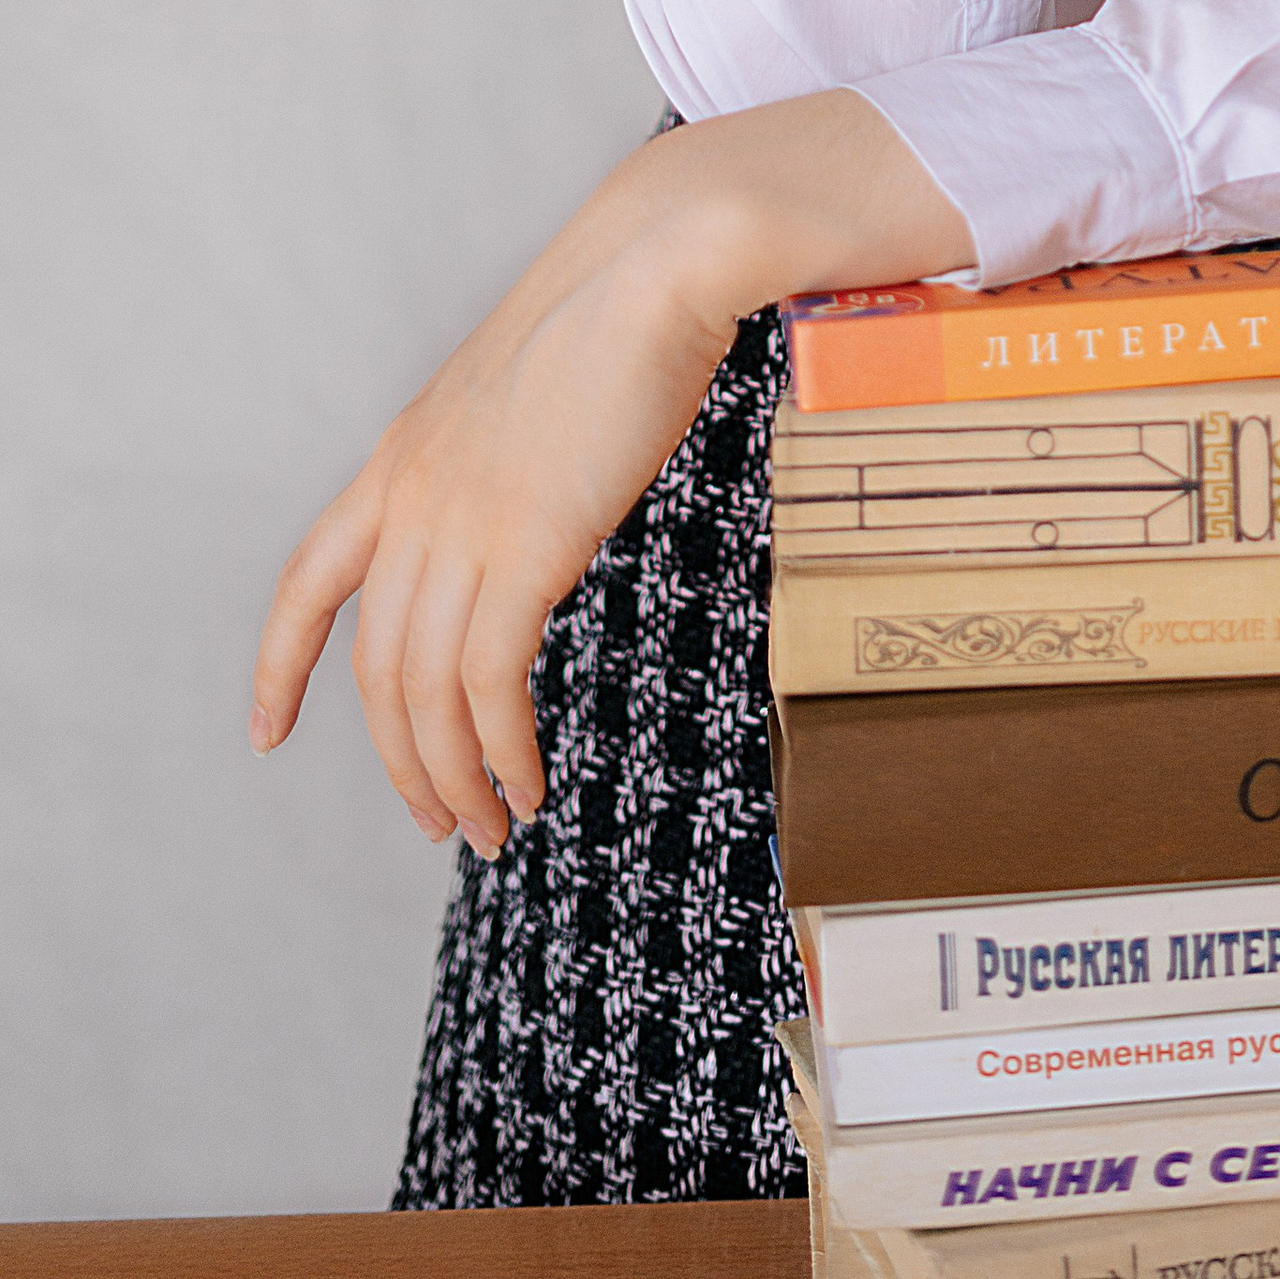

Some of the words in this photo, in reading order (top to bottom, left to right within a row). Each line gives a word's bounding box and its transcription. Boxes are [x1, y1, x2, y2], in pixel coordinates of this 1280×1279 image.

[1139, 617, 1267, 645] РУССКИЕ
[976, 1036, 1215, 1079] Современная
[940, 1154, 1138, 1207] НАЧНИ
[1153, 1150, 1193, 1189] С
